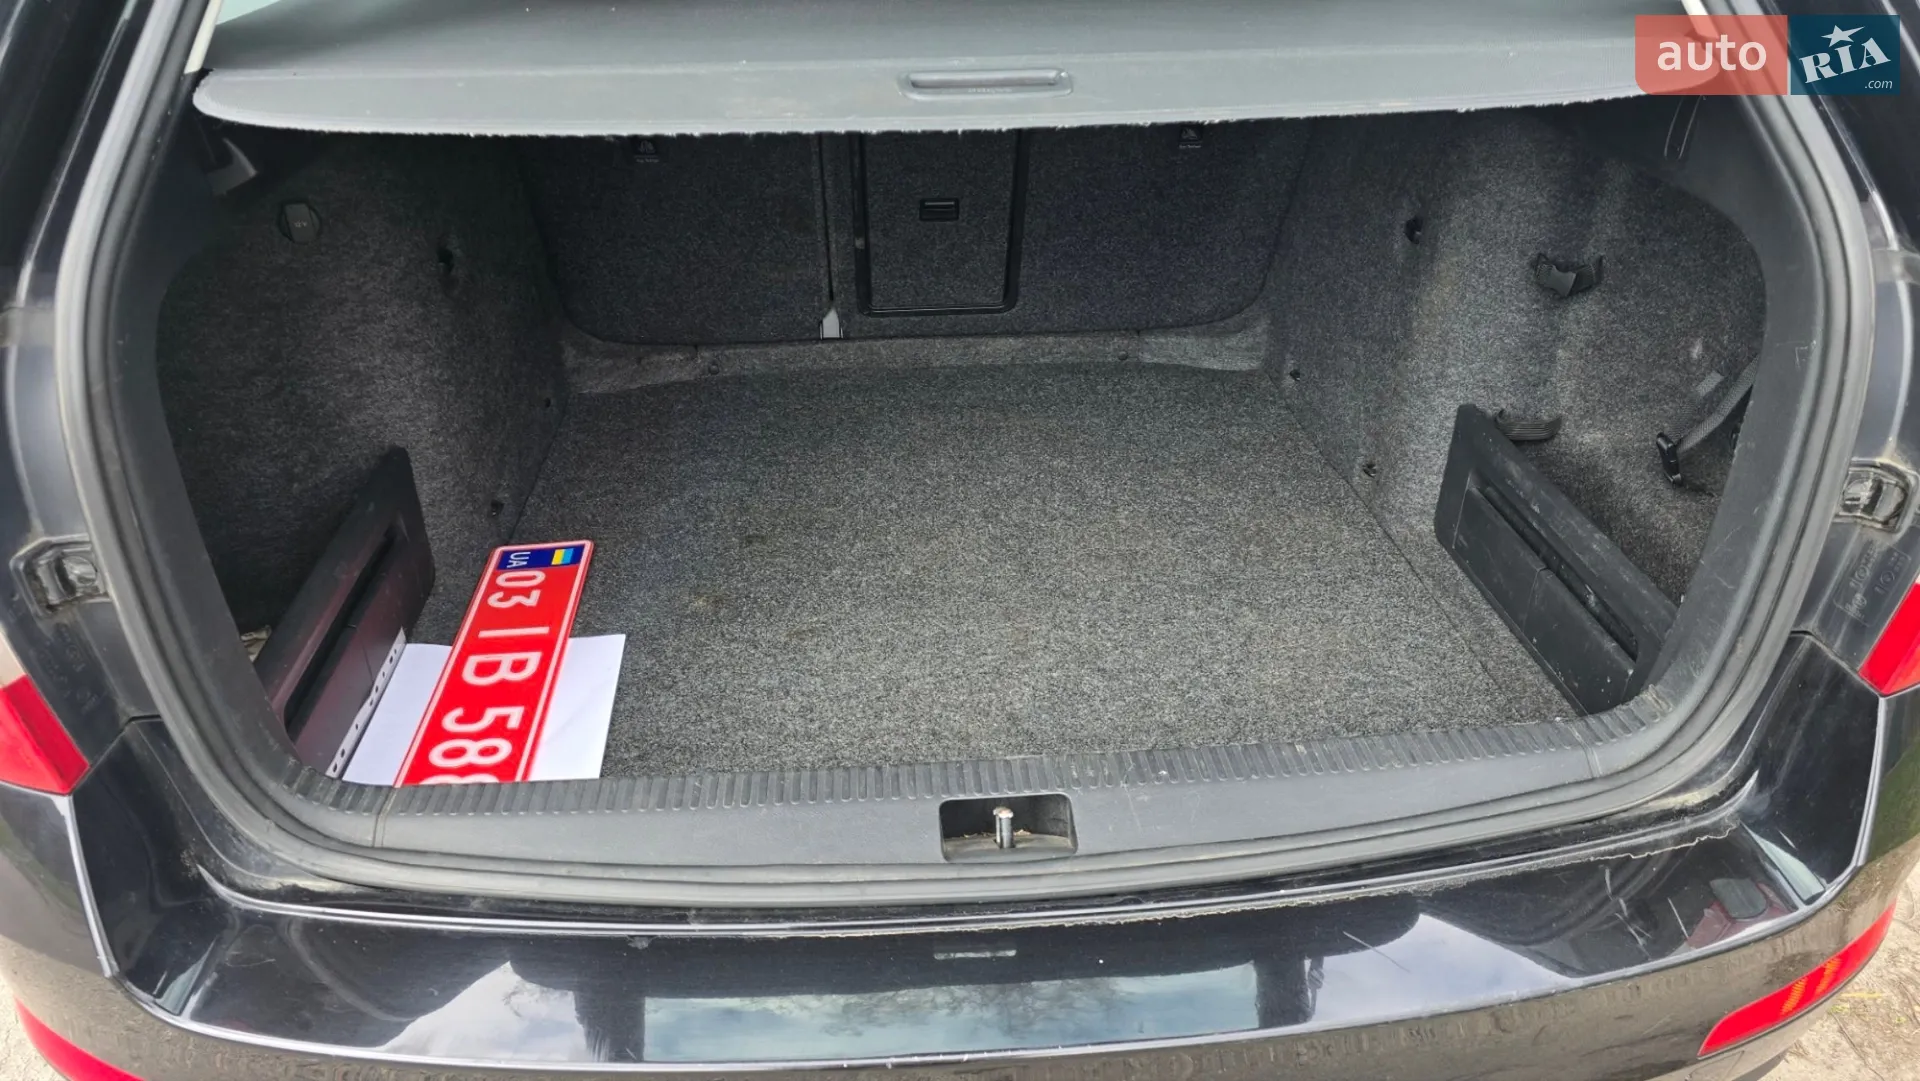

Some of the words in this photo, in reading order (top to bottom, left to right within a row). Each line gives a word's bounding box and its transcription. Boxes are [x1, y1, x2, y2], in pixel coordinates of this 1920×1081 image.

[506, 551, 531, 568] UA
[487, 570, 546, 609] 03
[419, 706, 525, 785] 58
